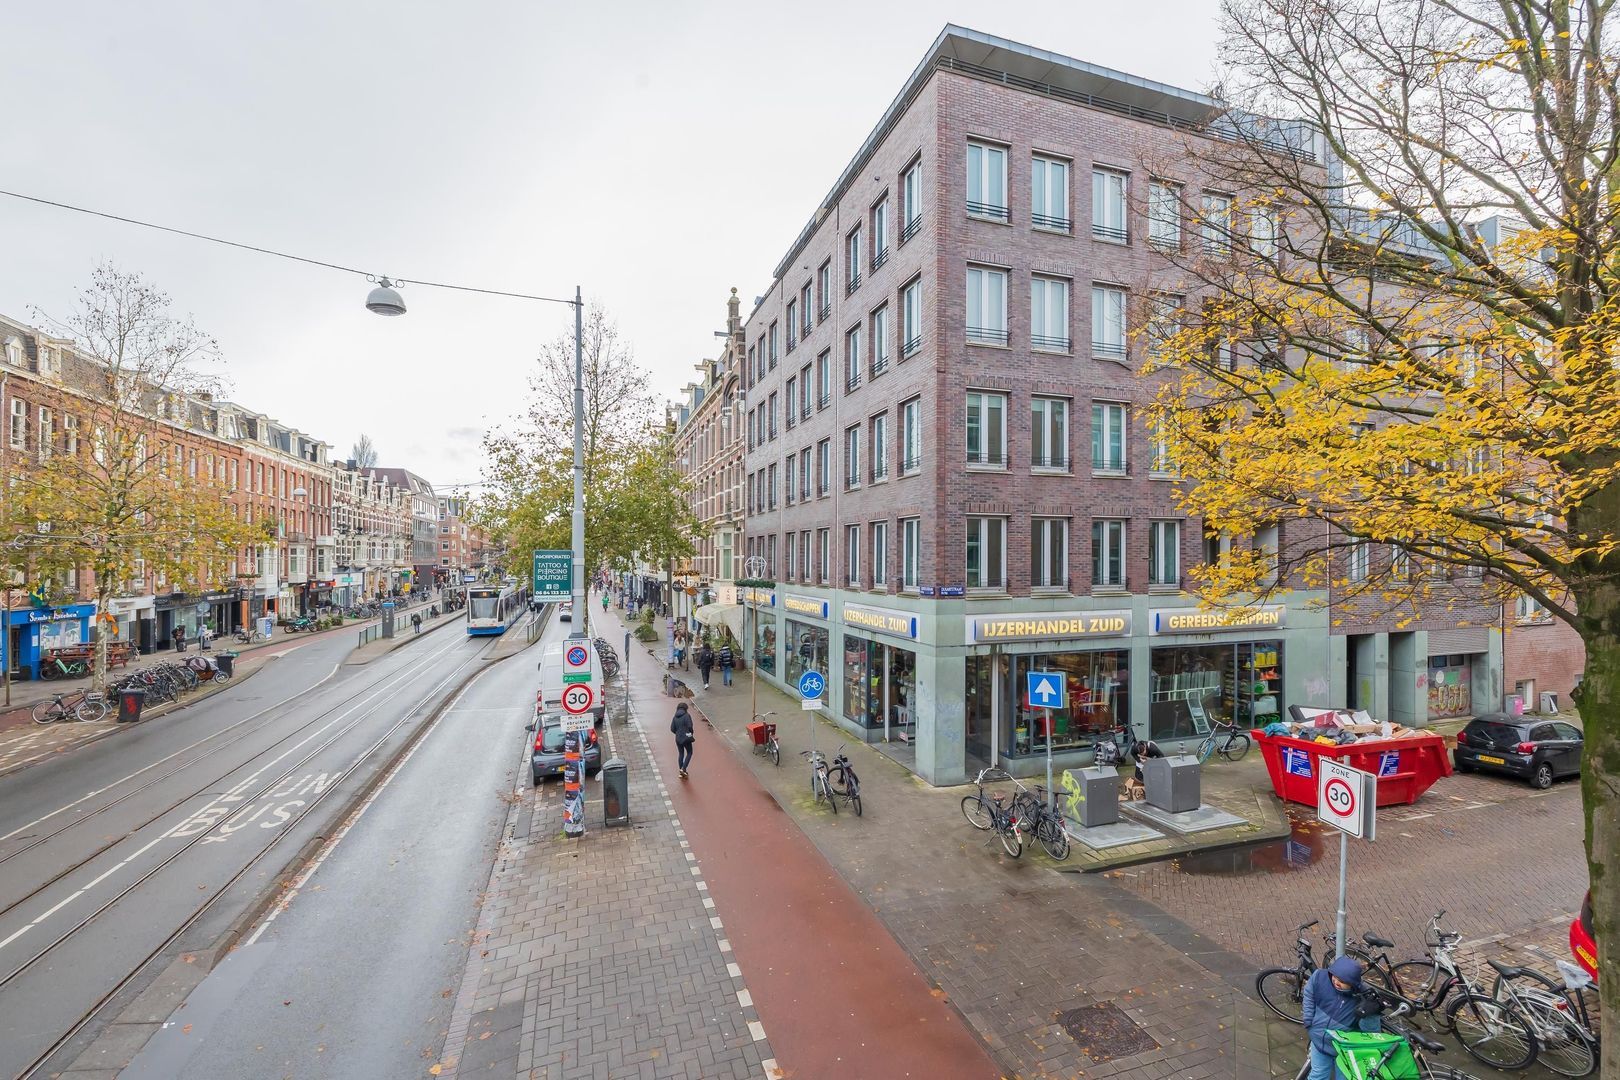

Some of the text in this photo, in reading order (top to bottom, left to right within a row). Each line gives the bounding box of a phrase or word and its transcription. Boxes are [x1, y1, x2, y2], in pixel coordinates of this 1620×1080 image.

[844, 609, 908, 632] IJZERHANDEL ZUID
[983, 618, 1125, 637] IJZERHANDEL ZUID
[568, 693, 588, 704] 30
[1331, 766, 1350, 779] ZONE
[1330, 787, 1350, 806] 30
